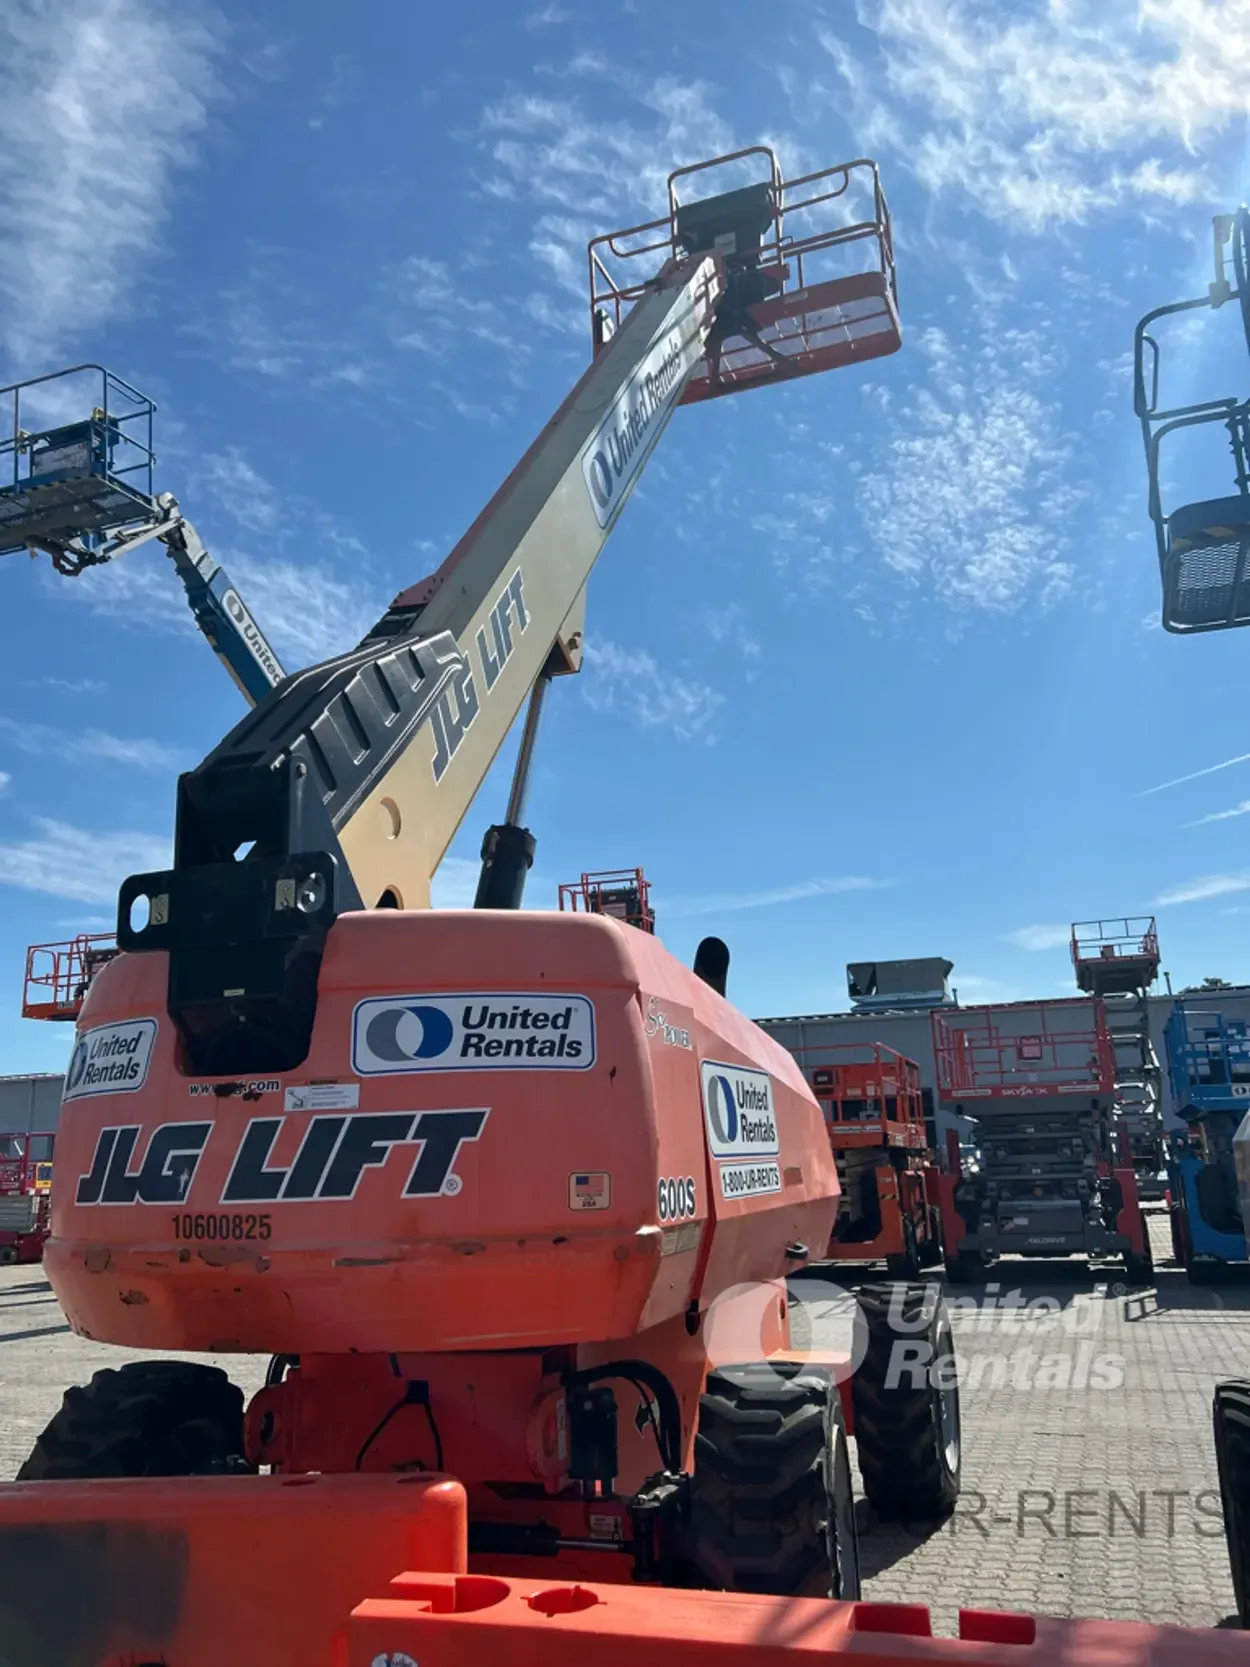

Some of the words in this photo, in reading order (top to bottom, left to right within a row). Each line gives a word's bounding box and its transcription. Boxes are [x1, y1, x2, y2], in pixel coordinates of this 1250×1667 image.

[608, 384, 656, 477] United
[645, 337, 682, 409] Rentals
[431, 650, 480, 787] JLG
[475, 566, 528, 695] LIFT
[462, 1006, 573, 1030] United
[90, 1031, 144, 1060] United
[460, 1033, 582, 1057] Rentals
[83, 1057, 140, 1085] Rentals
[735, 1080, 768, 1110] United
[740, 1113, 776, 1142] Rentals
[75, 1121, 215, 1206] JLG
[220, 1107, 491, 1203] LIFT
[722, 1167, 780, 1193] 1-800-UR-RENTS
[658, 1177, 696, 1221] 600S
[171, 1214, 271, 1239] 10600825
